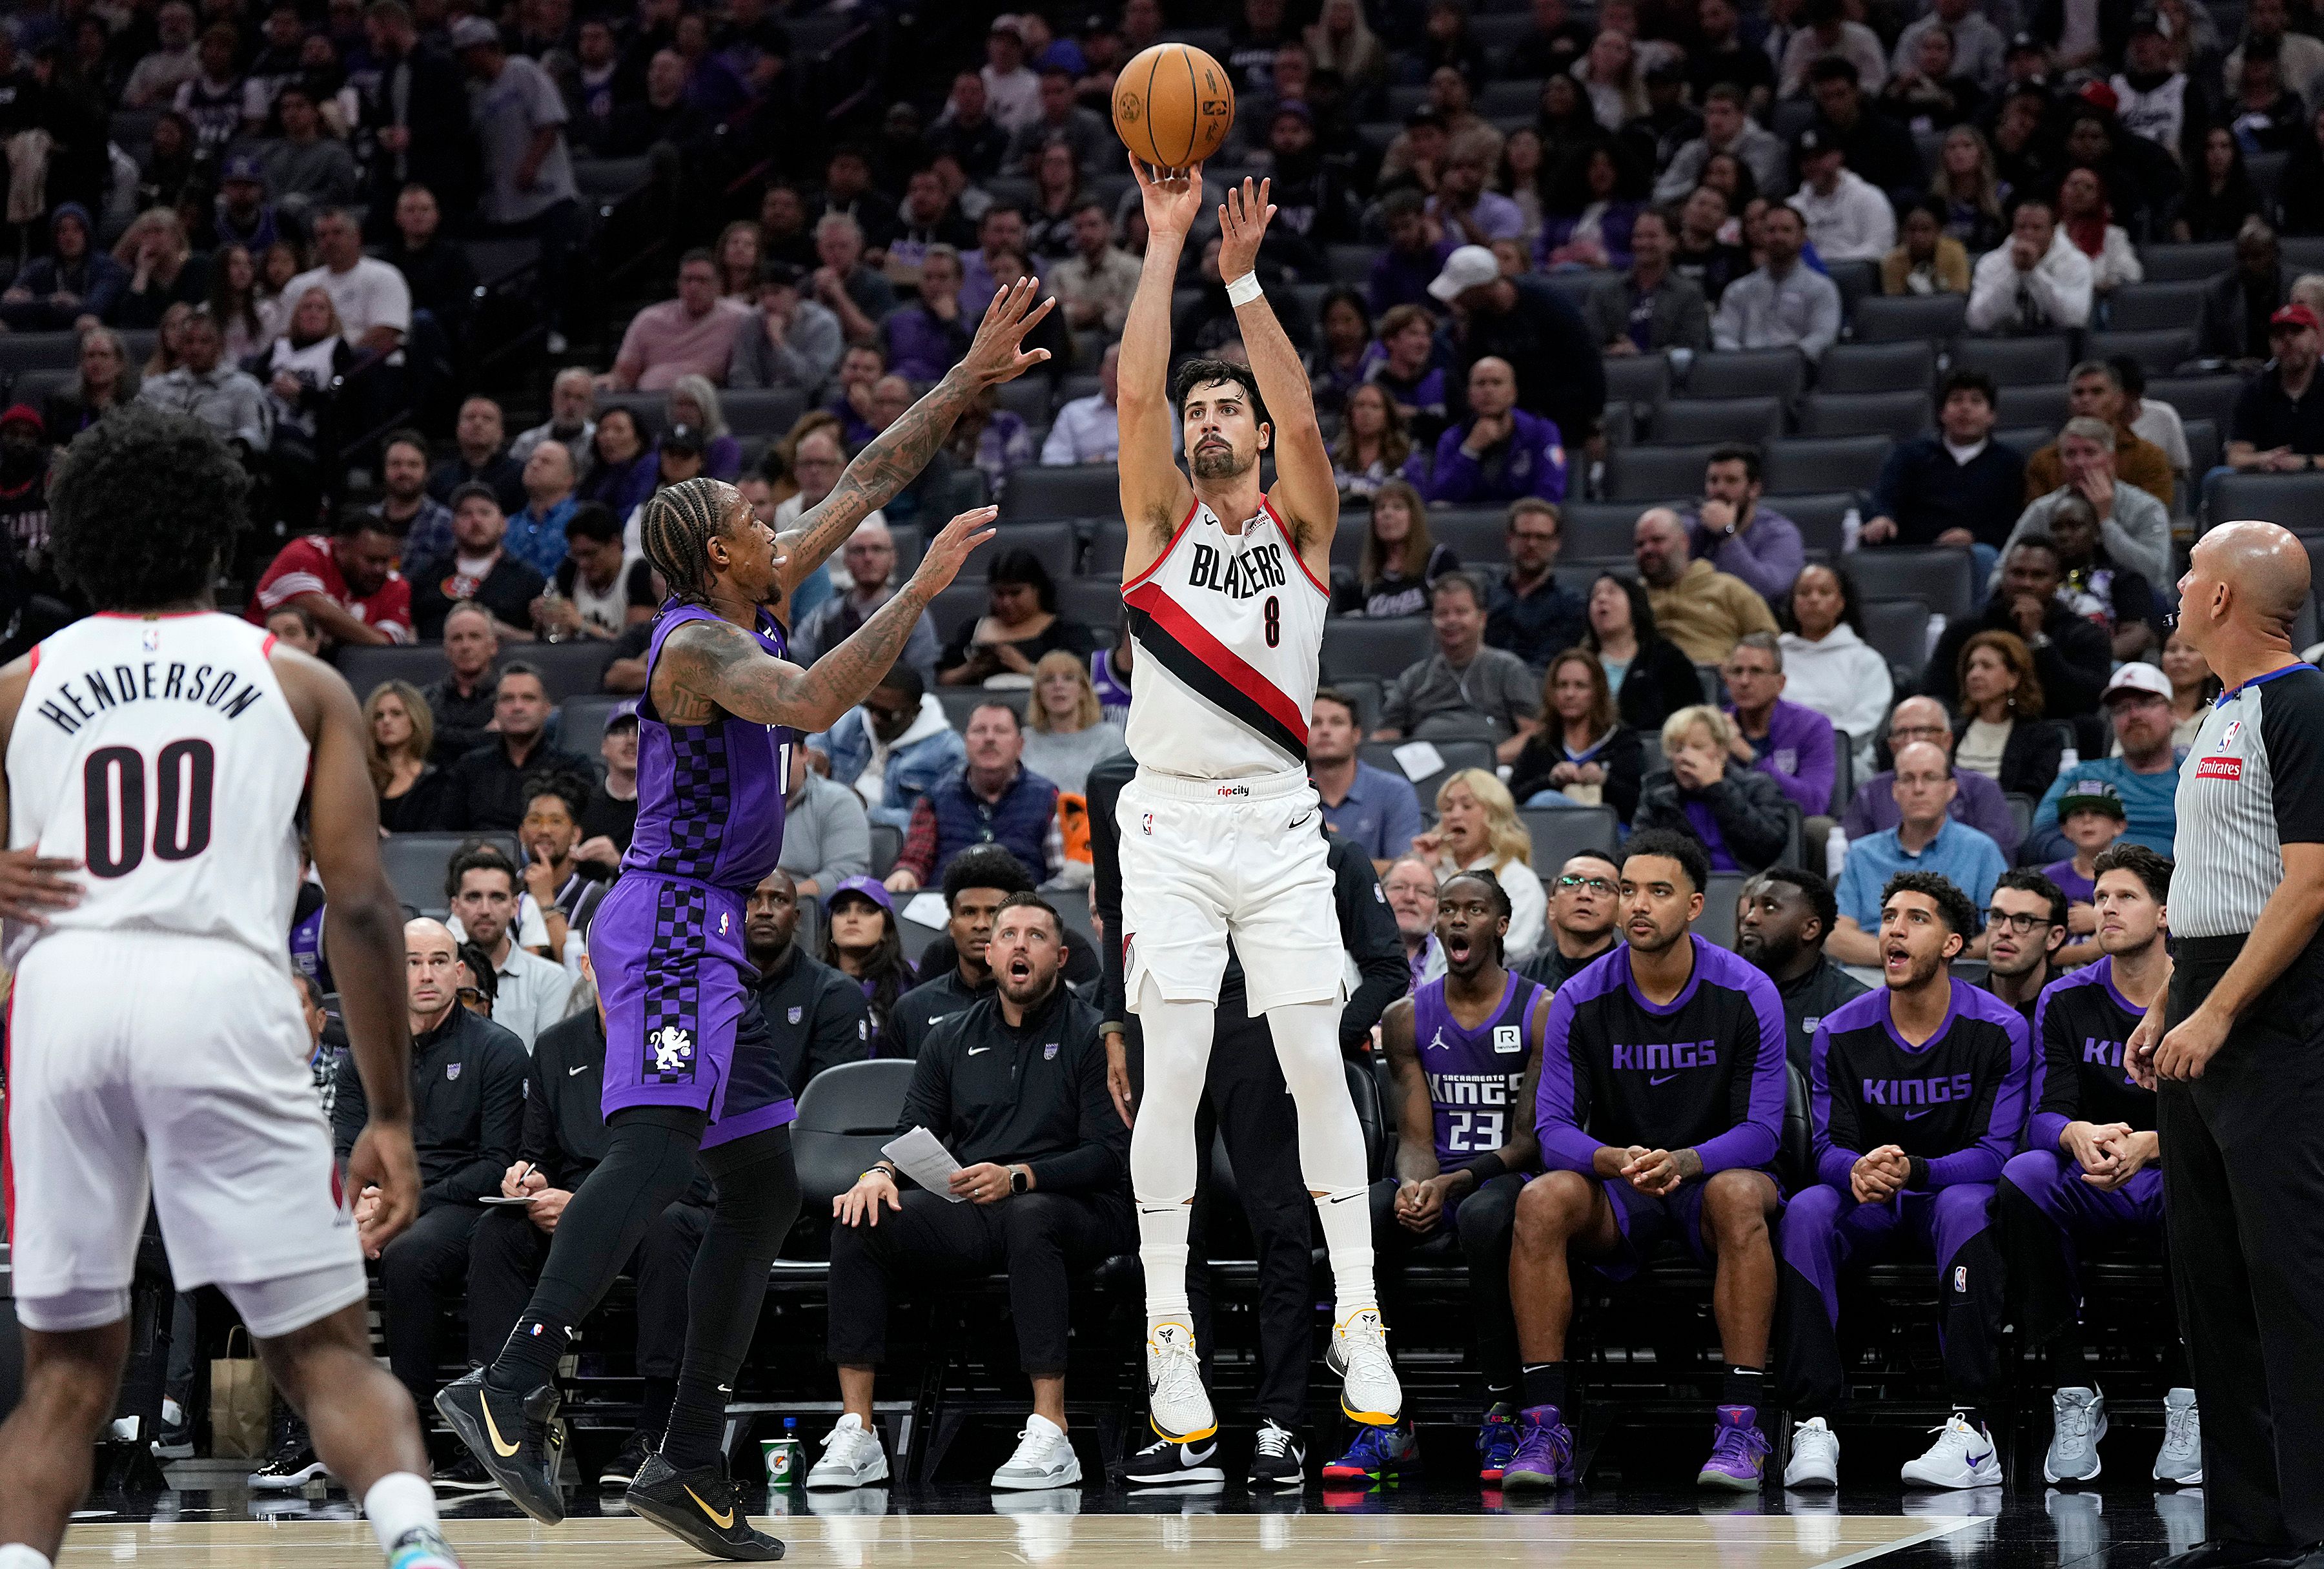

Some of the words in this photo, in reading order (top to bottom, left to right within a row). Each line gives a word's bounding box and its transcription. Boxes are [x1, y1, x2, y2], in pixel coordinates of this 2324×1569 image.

[1188, 542, 1286, 599] BLAZERS
[1264, 595, 1280, 648] 8
[38, 662, 262, 735] HENDERSON
[2197, 760, 2241, 776] Emirates
[1218, 785, 1249, 797] ripcity
[84, 738, 214, 879] 00
[1613, 1040, 1717, 1070] KINGS
[1442, 1074, 1505, 1082] SACRAMENTO
[1862, 1072, 1973, 1105] KINGS
[1449, 1111, 1504, 1151] 23
[768, 1449, 788, 1475] G
